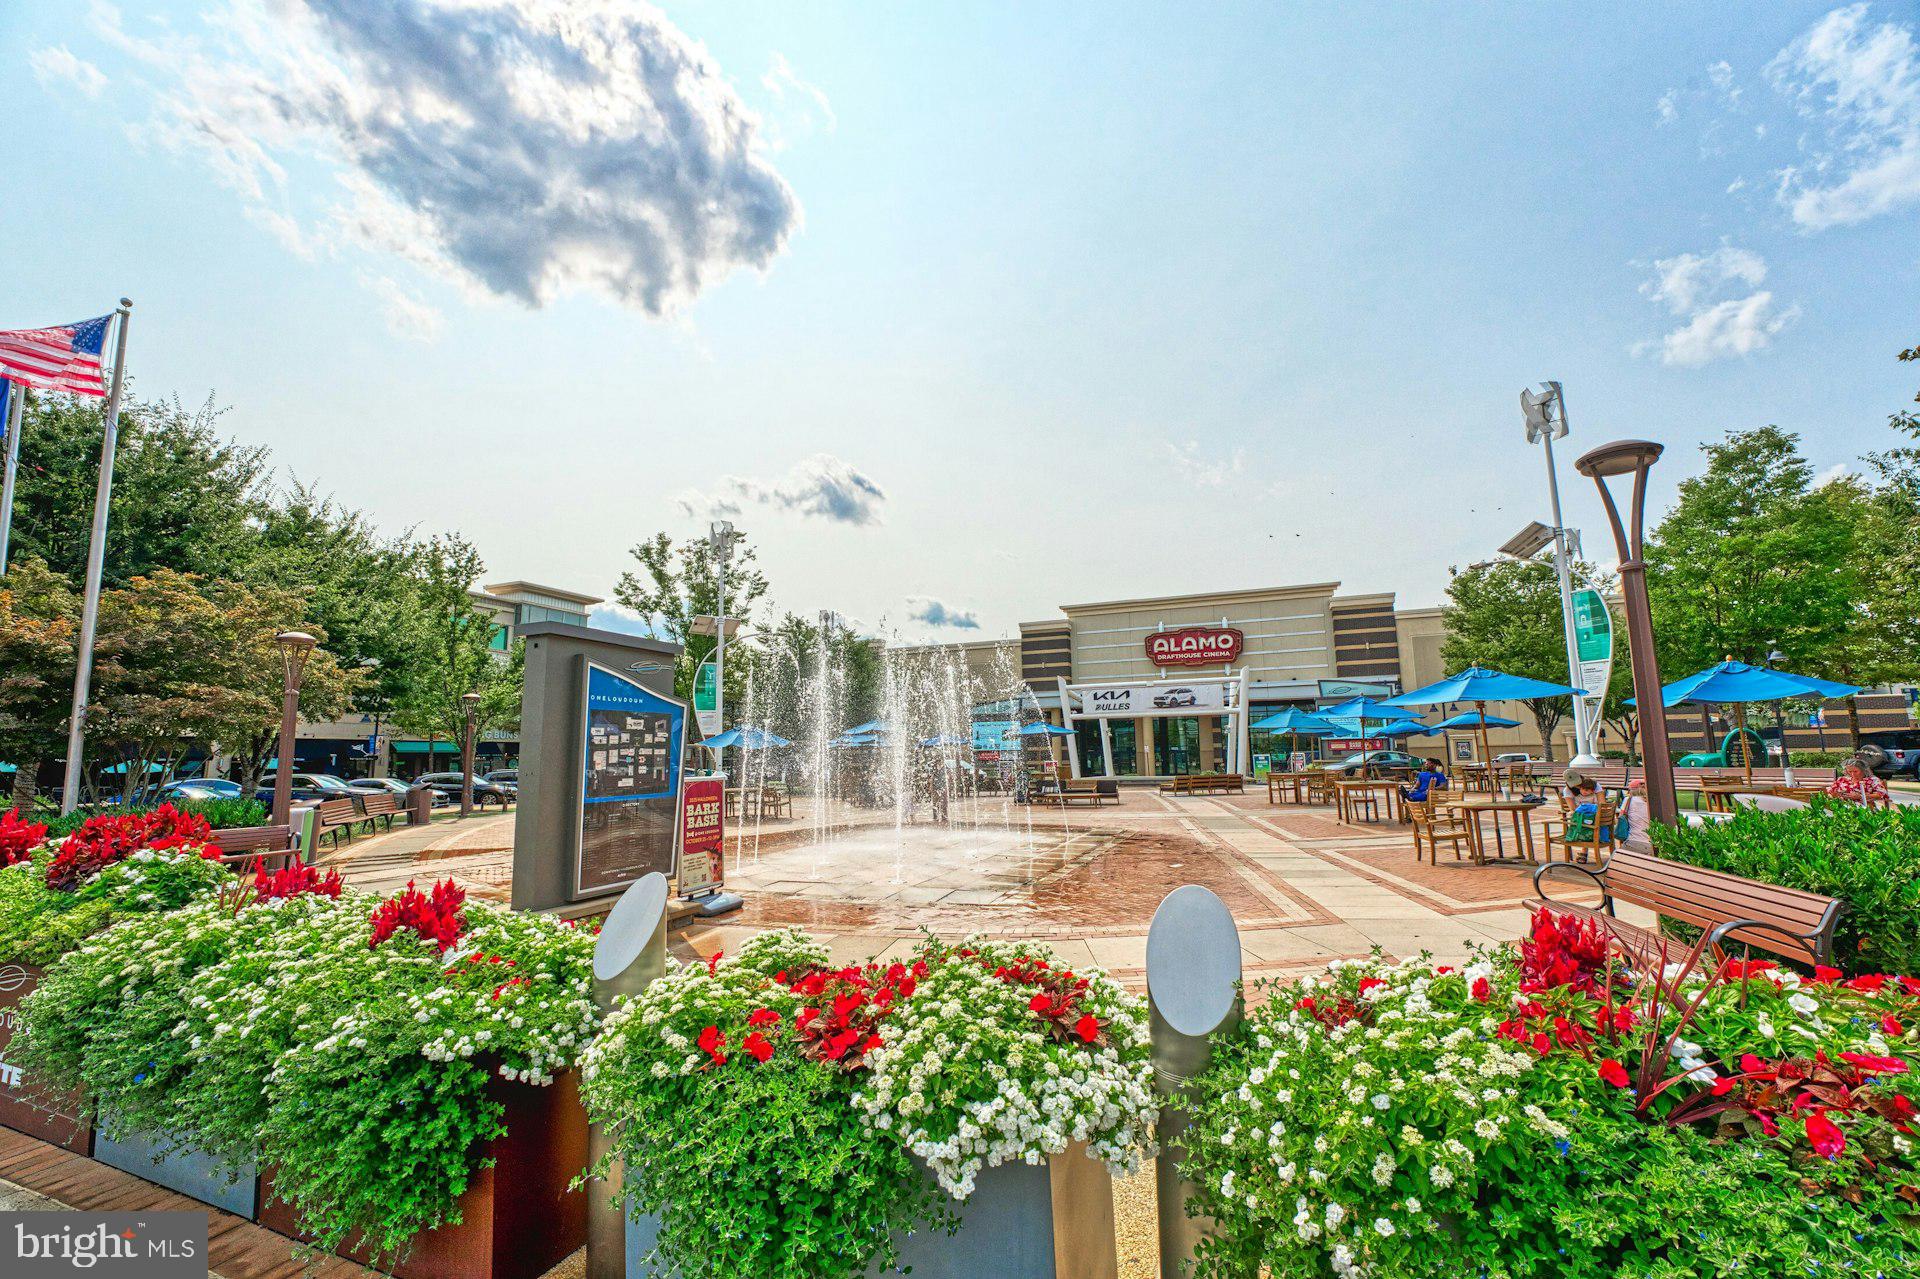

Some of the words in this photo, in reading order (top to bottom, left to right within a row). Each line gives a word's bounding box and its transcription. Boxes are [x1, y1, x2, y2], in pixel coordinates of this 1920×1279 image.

[1153, 634, 1234, 653] ALAMO
[1157, 652, 1201, 660] DRAFTHOUSE
[1203, 650, 1230, 658] CINEMA
[1093, 690, 1130, 701] KIA
[686, 802, 720, 817] BARK
[687, 814, 719, 829] BASH
